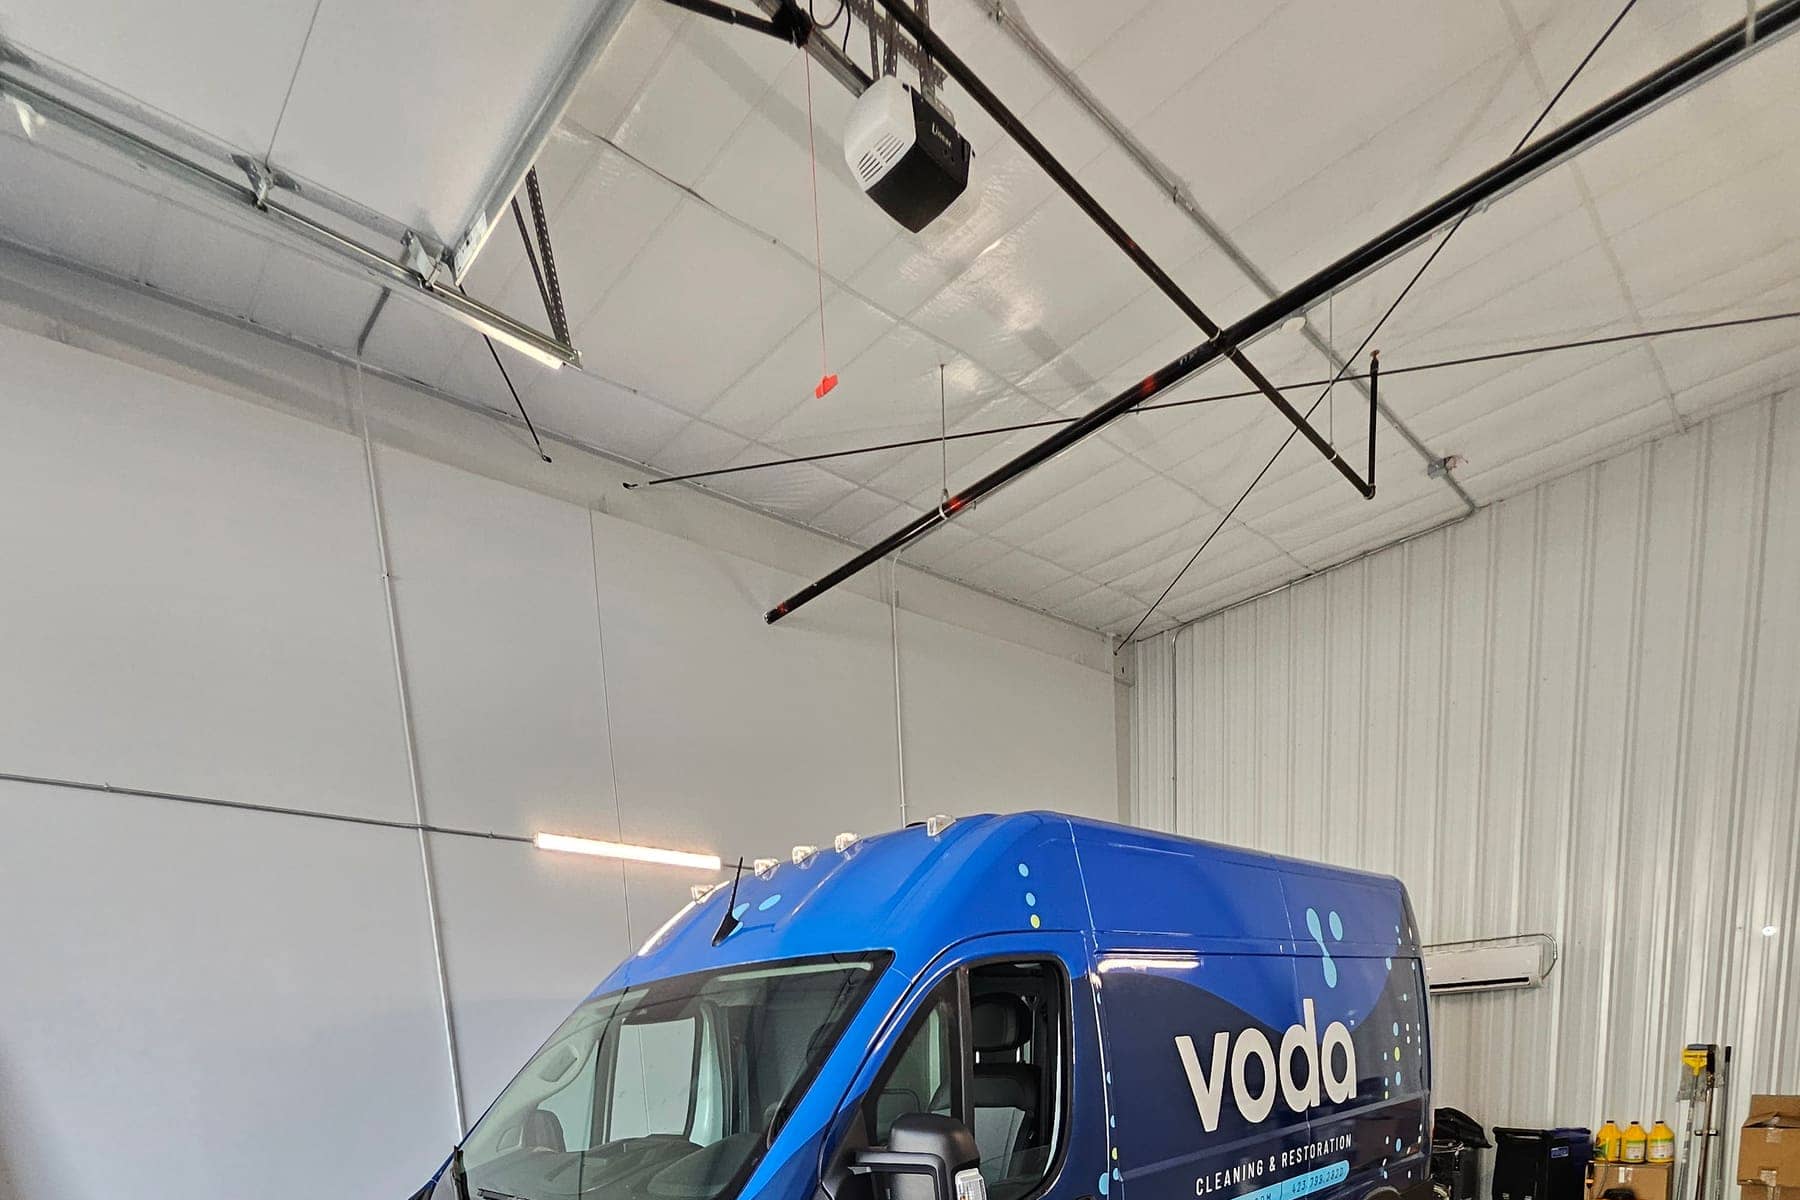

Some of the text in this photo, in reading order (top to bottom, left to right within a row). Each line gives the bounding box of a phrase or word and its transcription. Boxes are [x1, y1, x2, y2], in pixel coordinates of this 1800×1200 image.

[1174, 998, 1357, 1132] voda
[1195, 1133, 1352, 1196] CLEANING & RESTORATION
